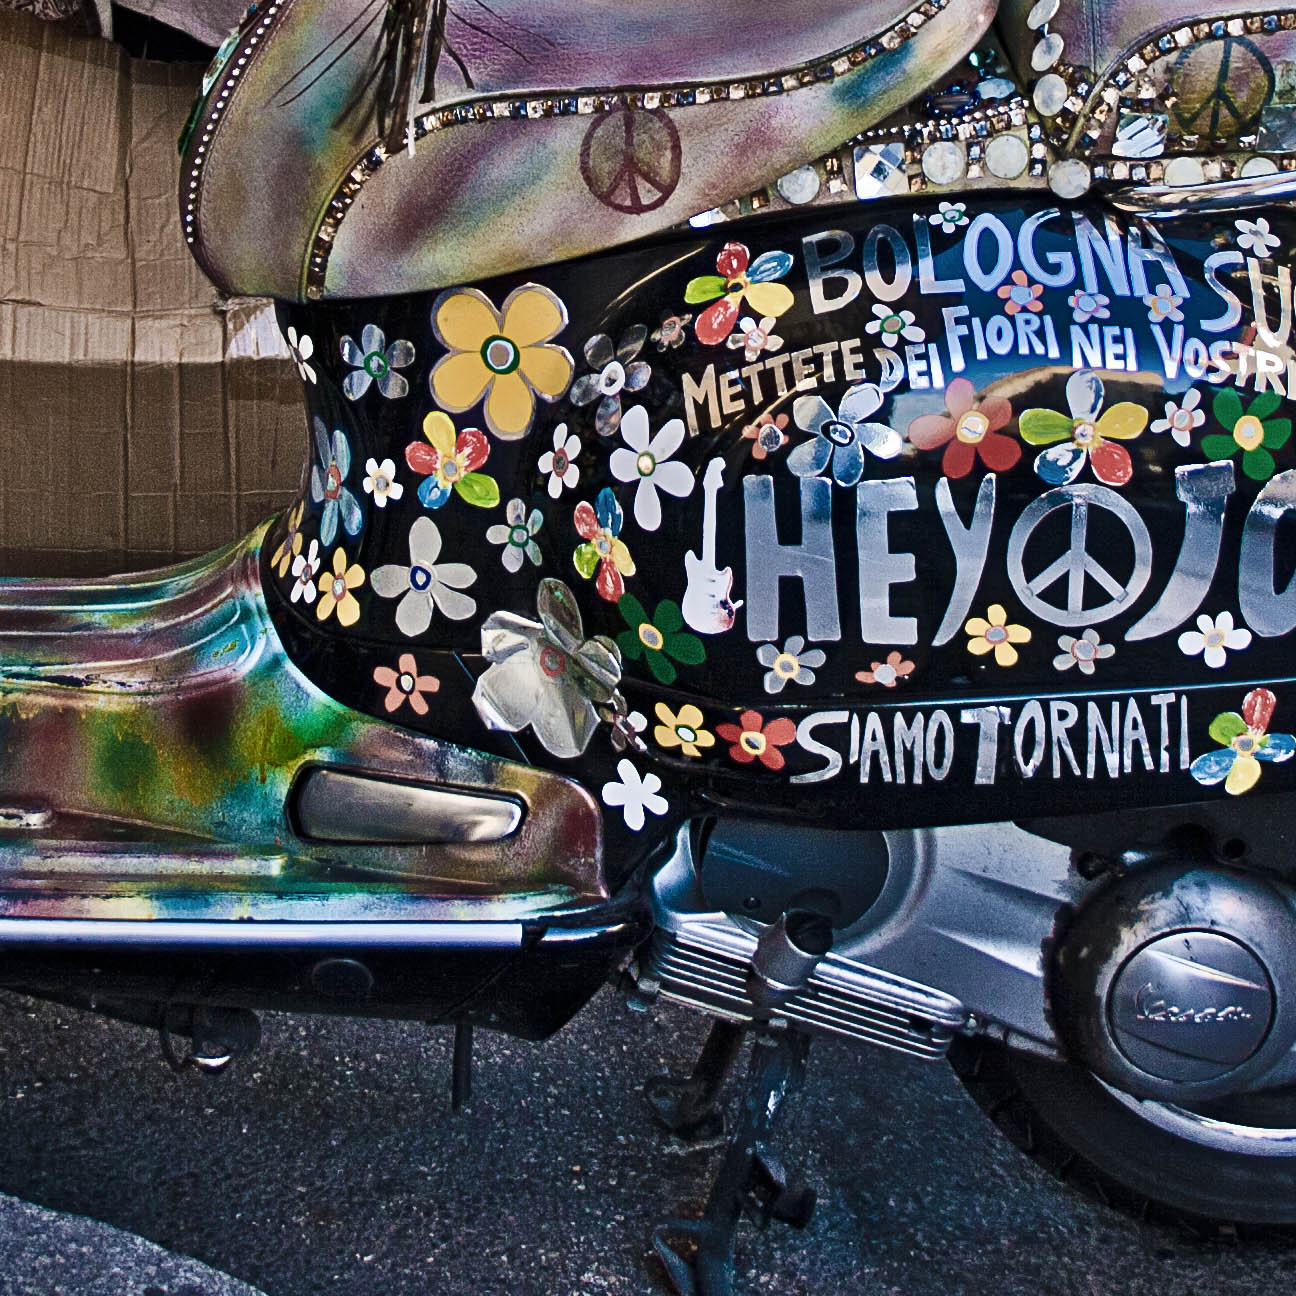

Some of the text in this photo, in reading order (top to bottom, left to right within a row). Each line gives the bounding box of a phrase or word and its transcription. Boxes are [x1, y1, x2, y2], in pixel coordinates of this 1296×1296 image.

[801, 207, 1190, 316] BOLOGNA
[682, 338, 866, 439] METTETE
[878, 342, 946, 394] DEI
[942, 305, 1060, 373] FIORI
[1070, 324, 1137, 371] NEI
[742, 471, 997, 648] HEY
[790, 704, 955, 785] SIAMO
[959, 692, 1191, 786] TORNATI
